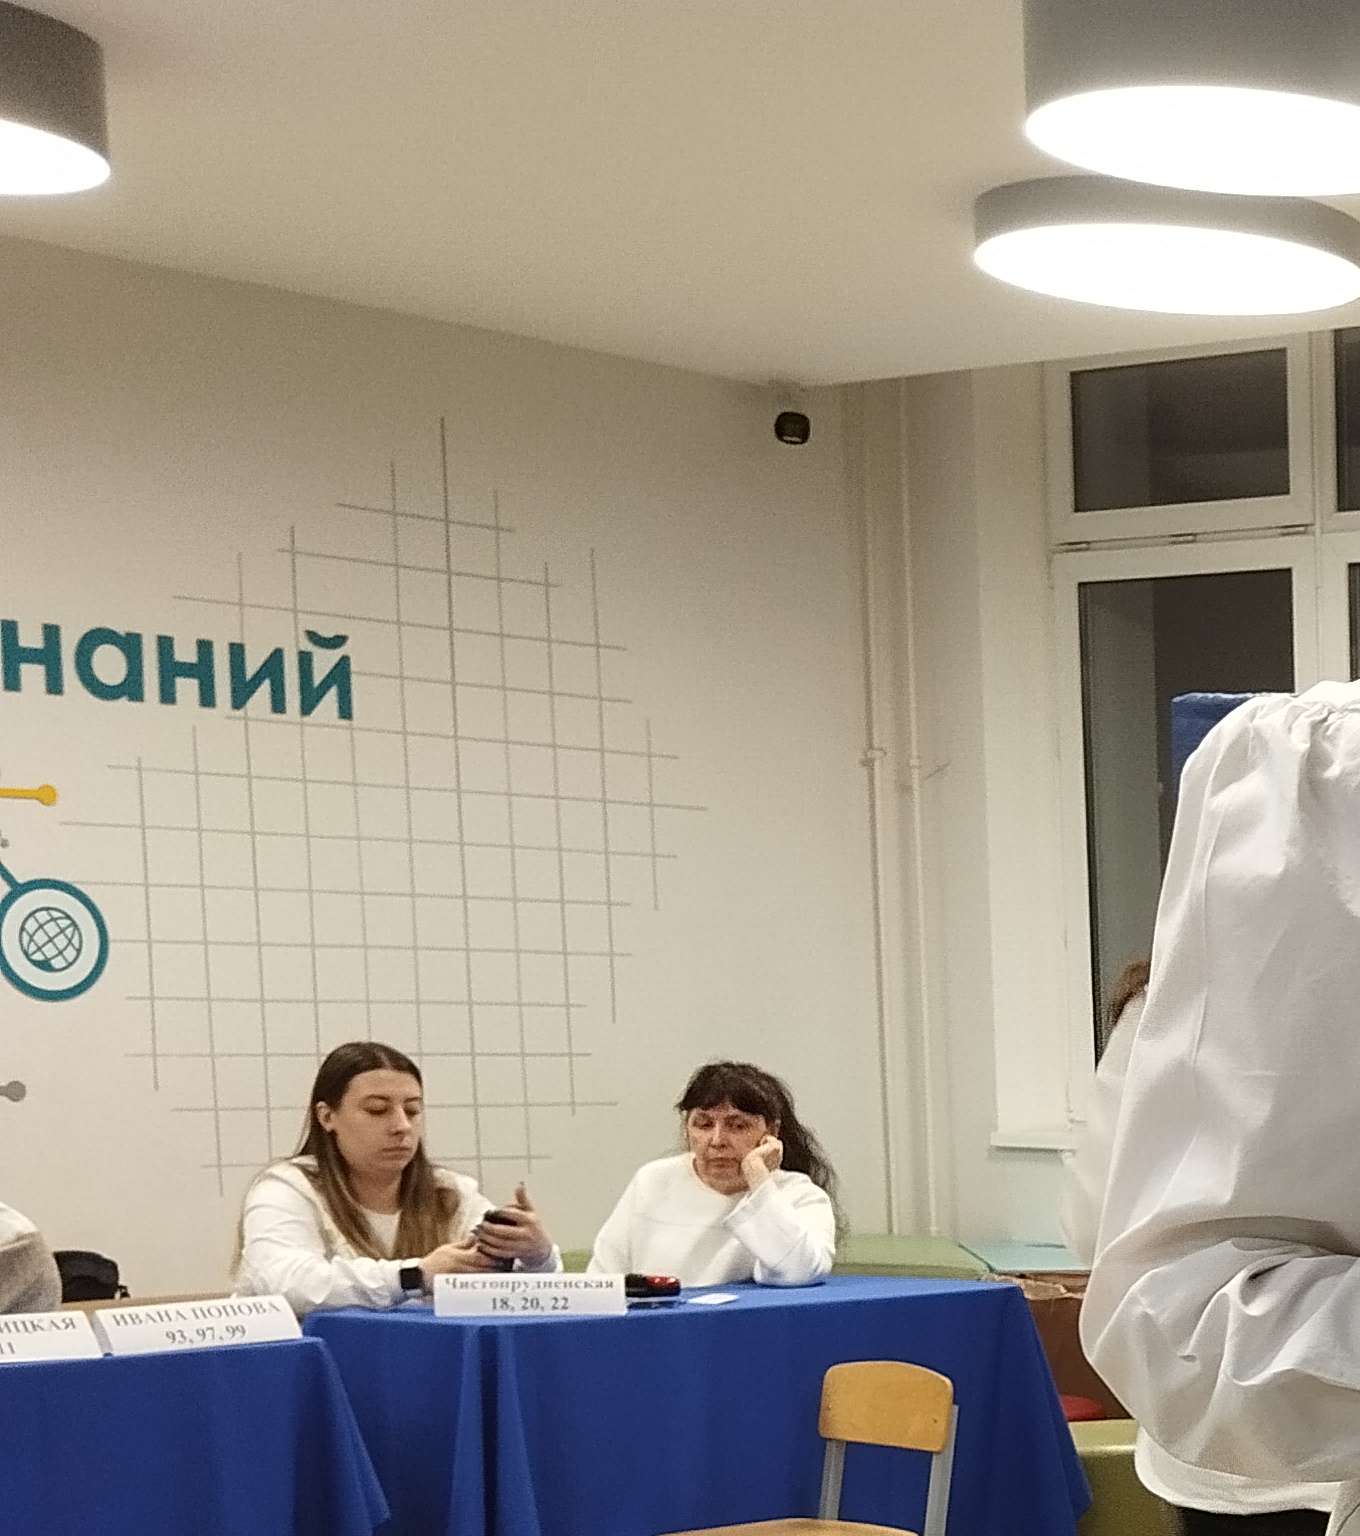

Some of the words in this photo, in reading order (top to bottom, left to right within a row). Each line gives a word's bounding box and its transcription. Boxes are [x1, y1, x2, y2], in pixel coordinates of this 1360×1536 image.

[0, 618, 354, 721] наний
[112, 1310, 187, 1326] ИВАНА
[191, 1301, 281, 1320] ПОПОВА
[491, 1297, 515, 1312] 18,
[521, 1297, 545, 1312] 20,
[551, 1296, 570, 1310] 22
[225, 1324, 246, 1339] 99
